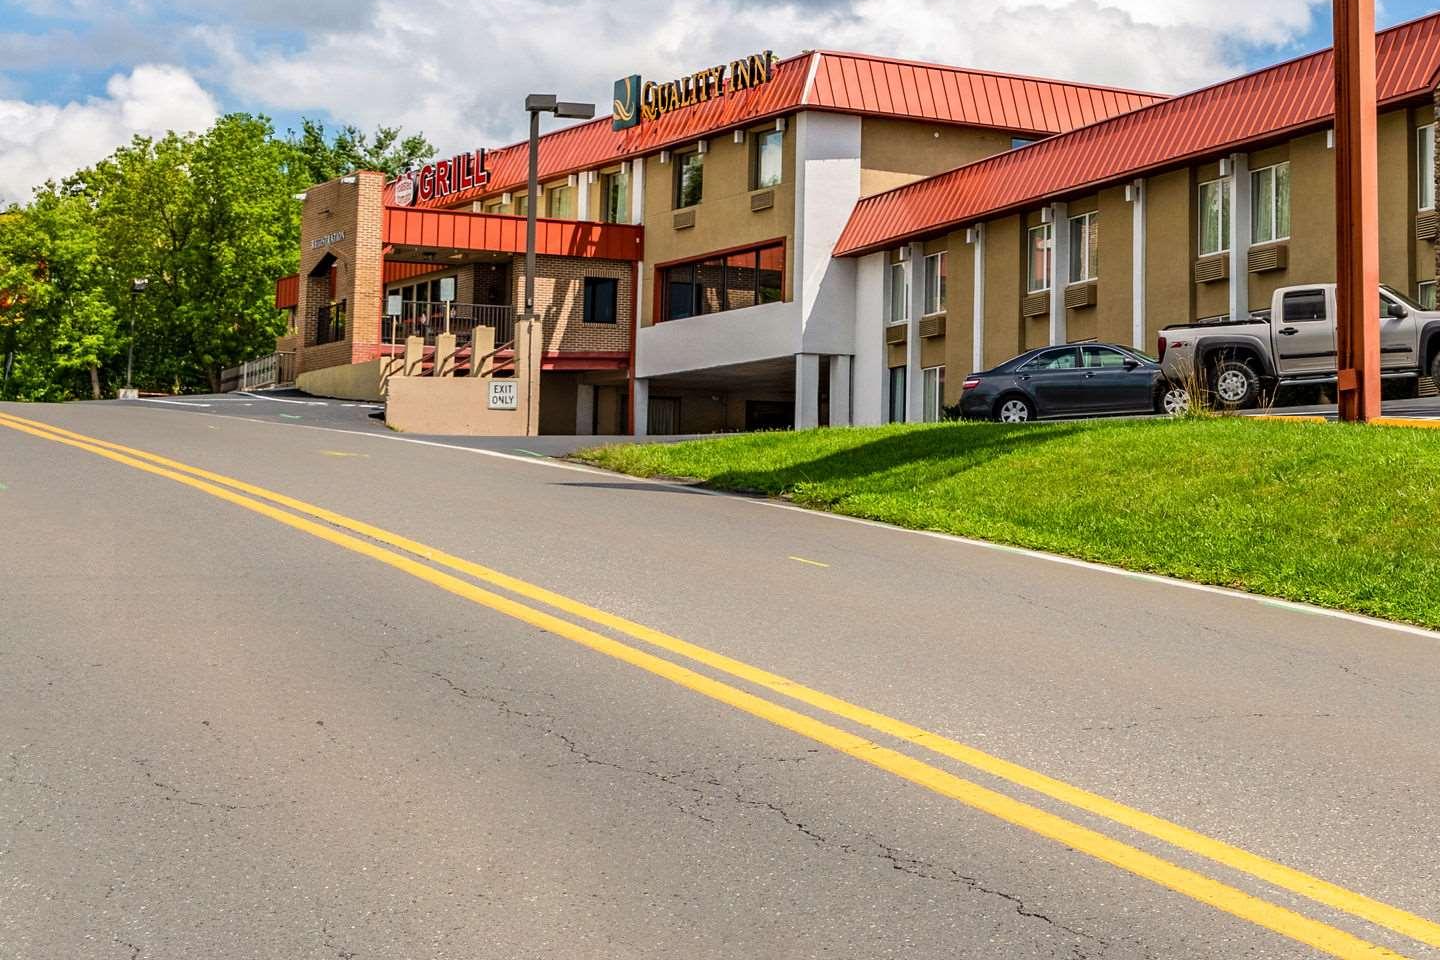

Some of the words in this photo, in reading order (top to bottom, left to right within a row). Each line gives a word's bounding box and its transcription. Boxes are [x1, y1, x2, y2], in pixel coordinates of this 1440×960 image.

[641, 65, 726, 121] QUALITY
[728, 50, 772, 93] INN
[419, 149, 488, 202] GRILL
[491, 395, 514, 405] ONLY
[493, 384, 513, 394] EXIT
